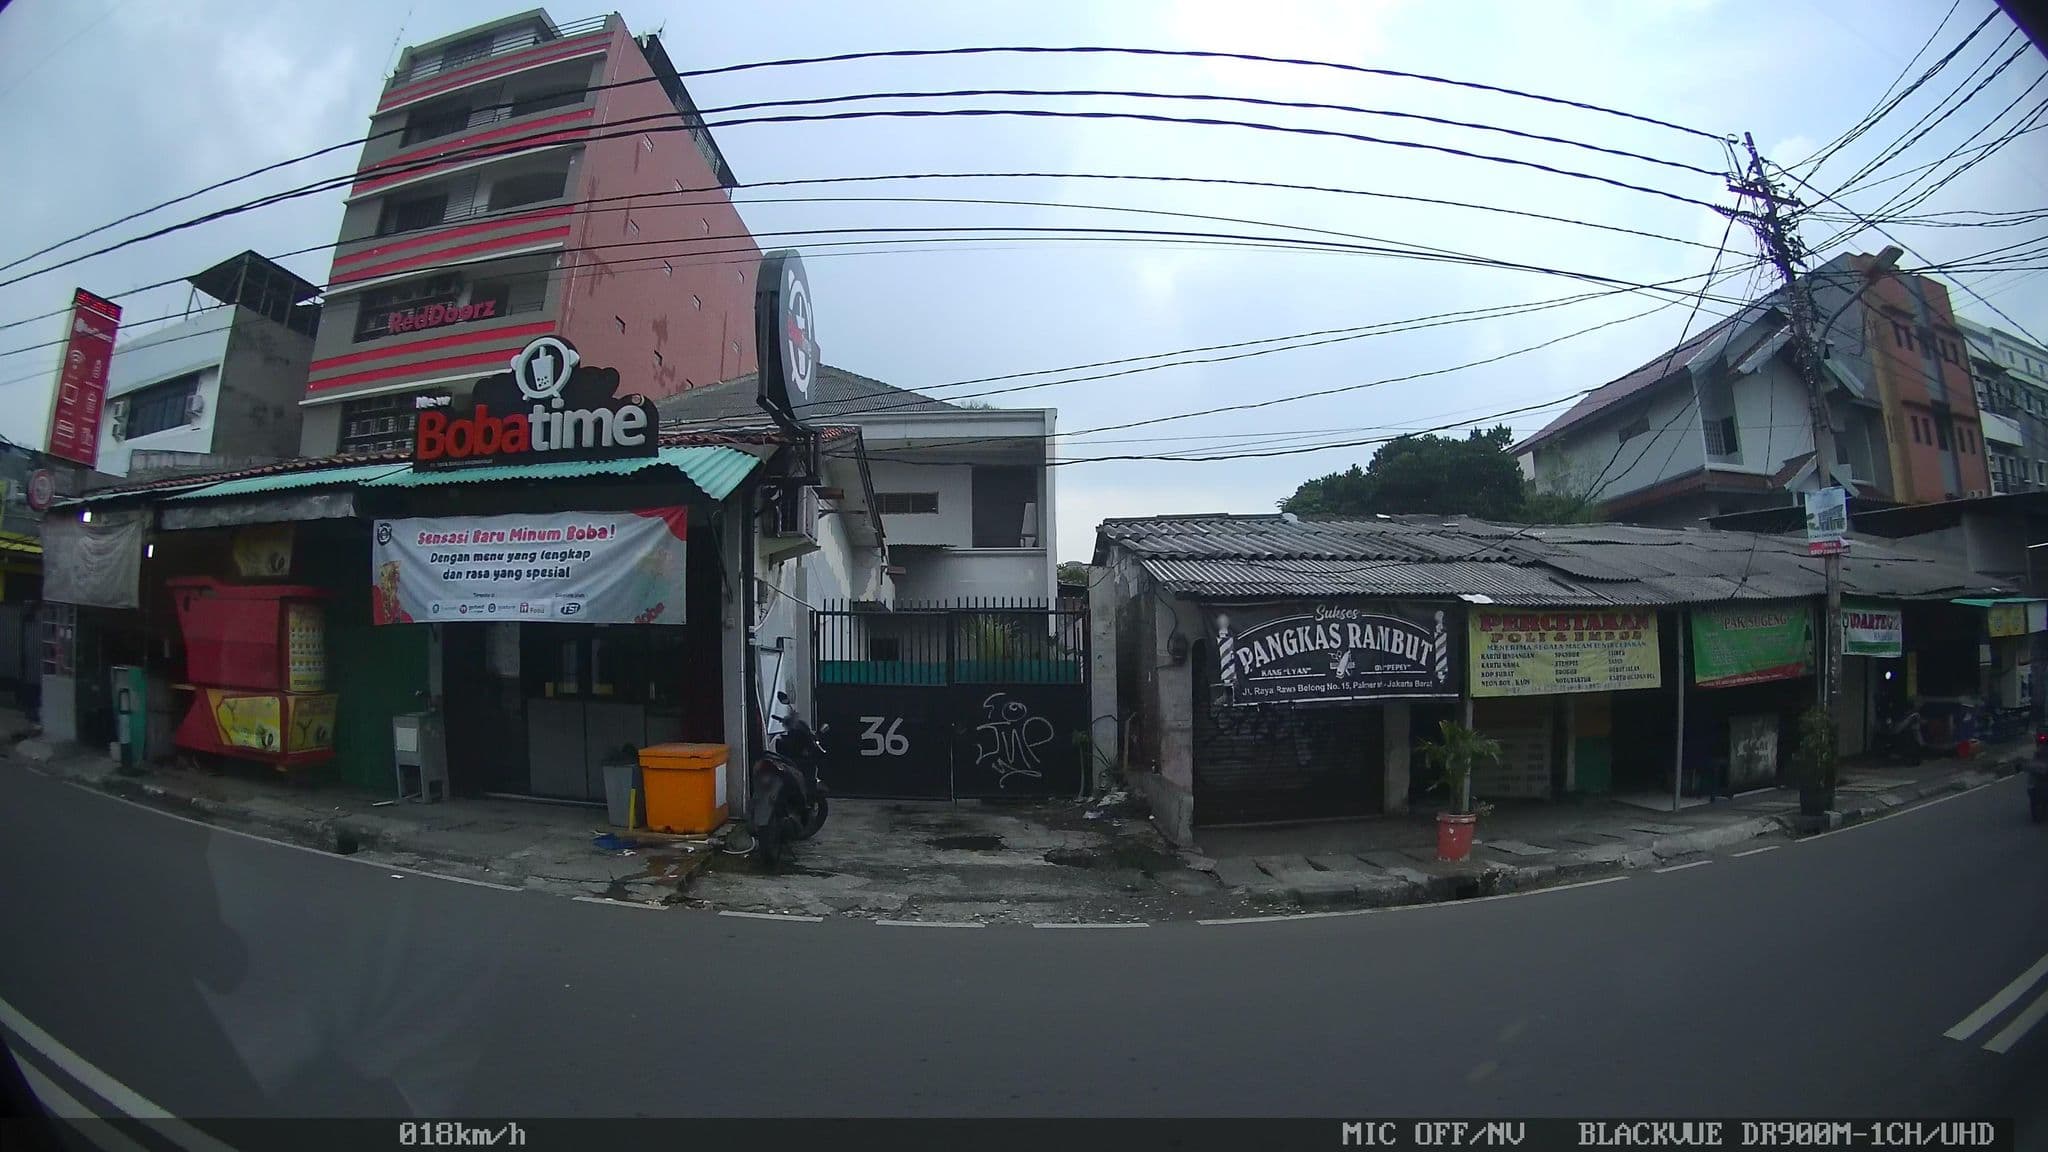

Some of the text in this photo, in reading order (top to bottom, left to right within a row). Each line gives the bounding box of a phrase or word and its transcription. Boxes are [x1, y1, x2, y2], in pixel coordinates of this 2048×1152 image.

[387, 298, 497, 333] RedDoorz
[415, 395, 452, 410] New
[417, 524, 616, 546] Sensasi Baru Minum Boba!
[430, 548, 591, 565] Dengan menu yang lengkap
[443, 566, 570, 581] dan rasa yang spesial
[1315, 604, 1361, 622] Sukses
[1236, 622, 1433, 675] PANGKAS RAMBUT
[1254, 687, 1274, 697] Raya
[1297, 683, 1326, 692] Belong
[859, 715, 910, 757] 36
